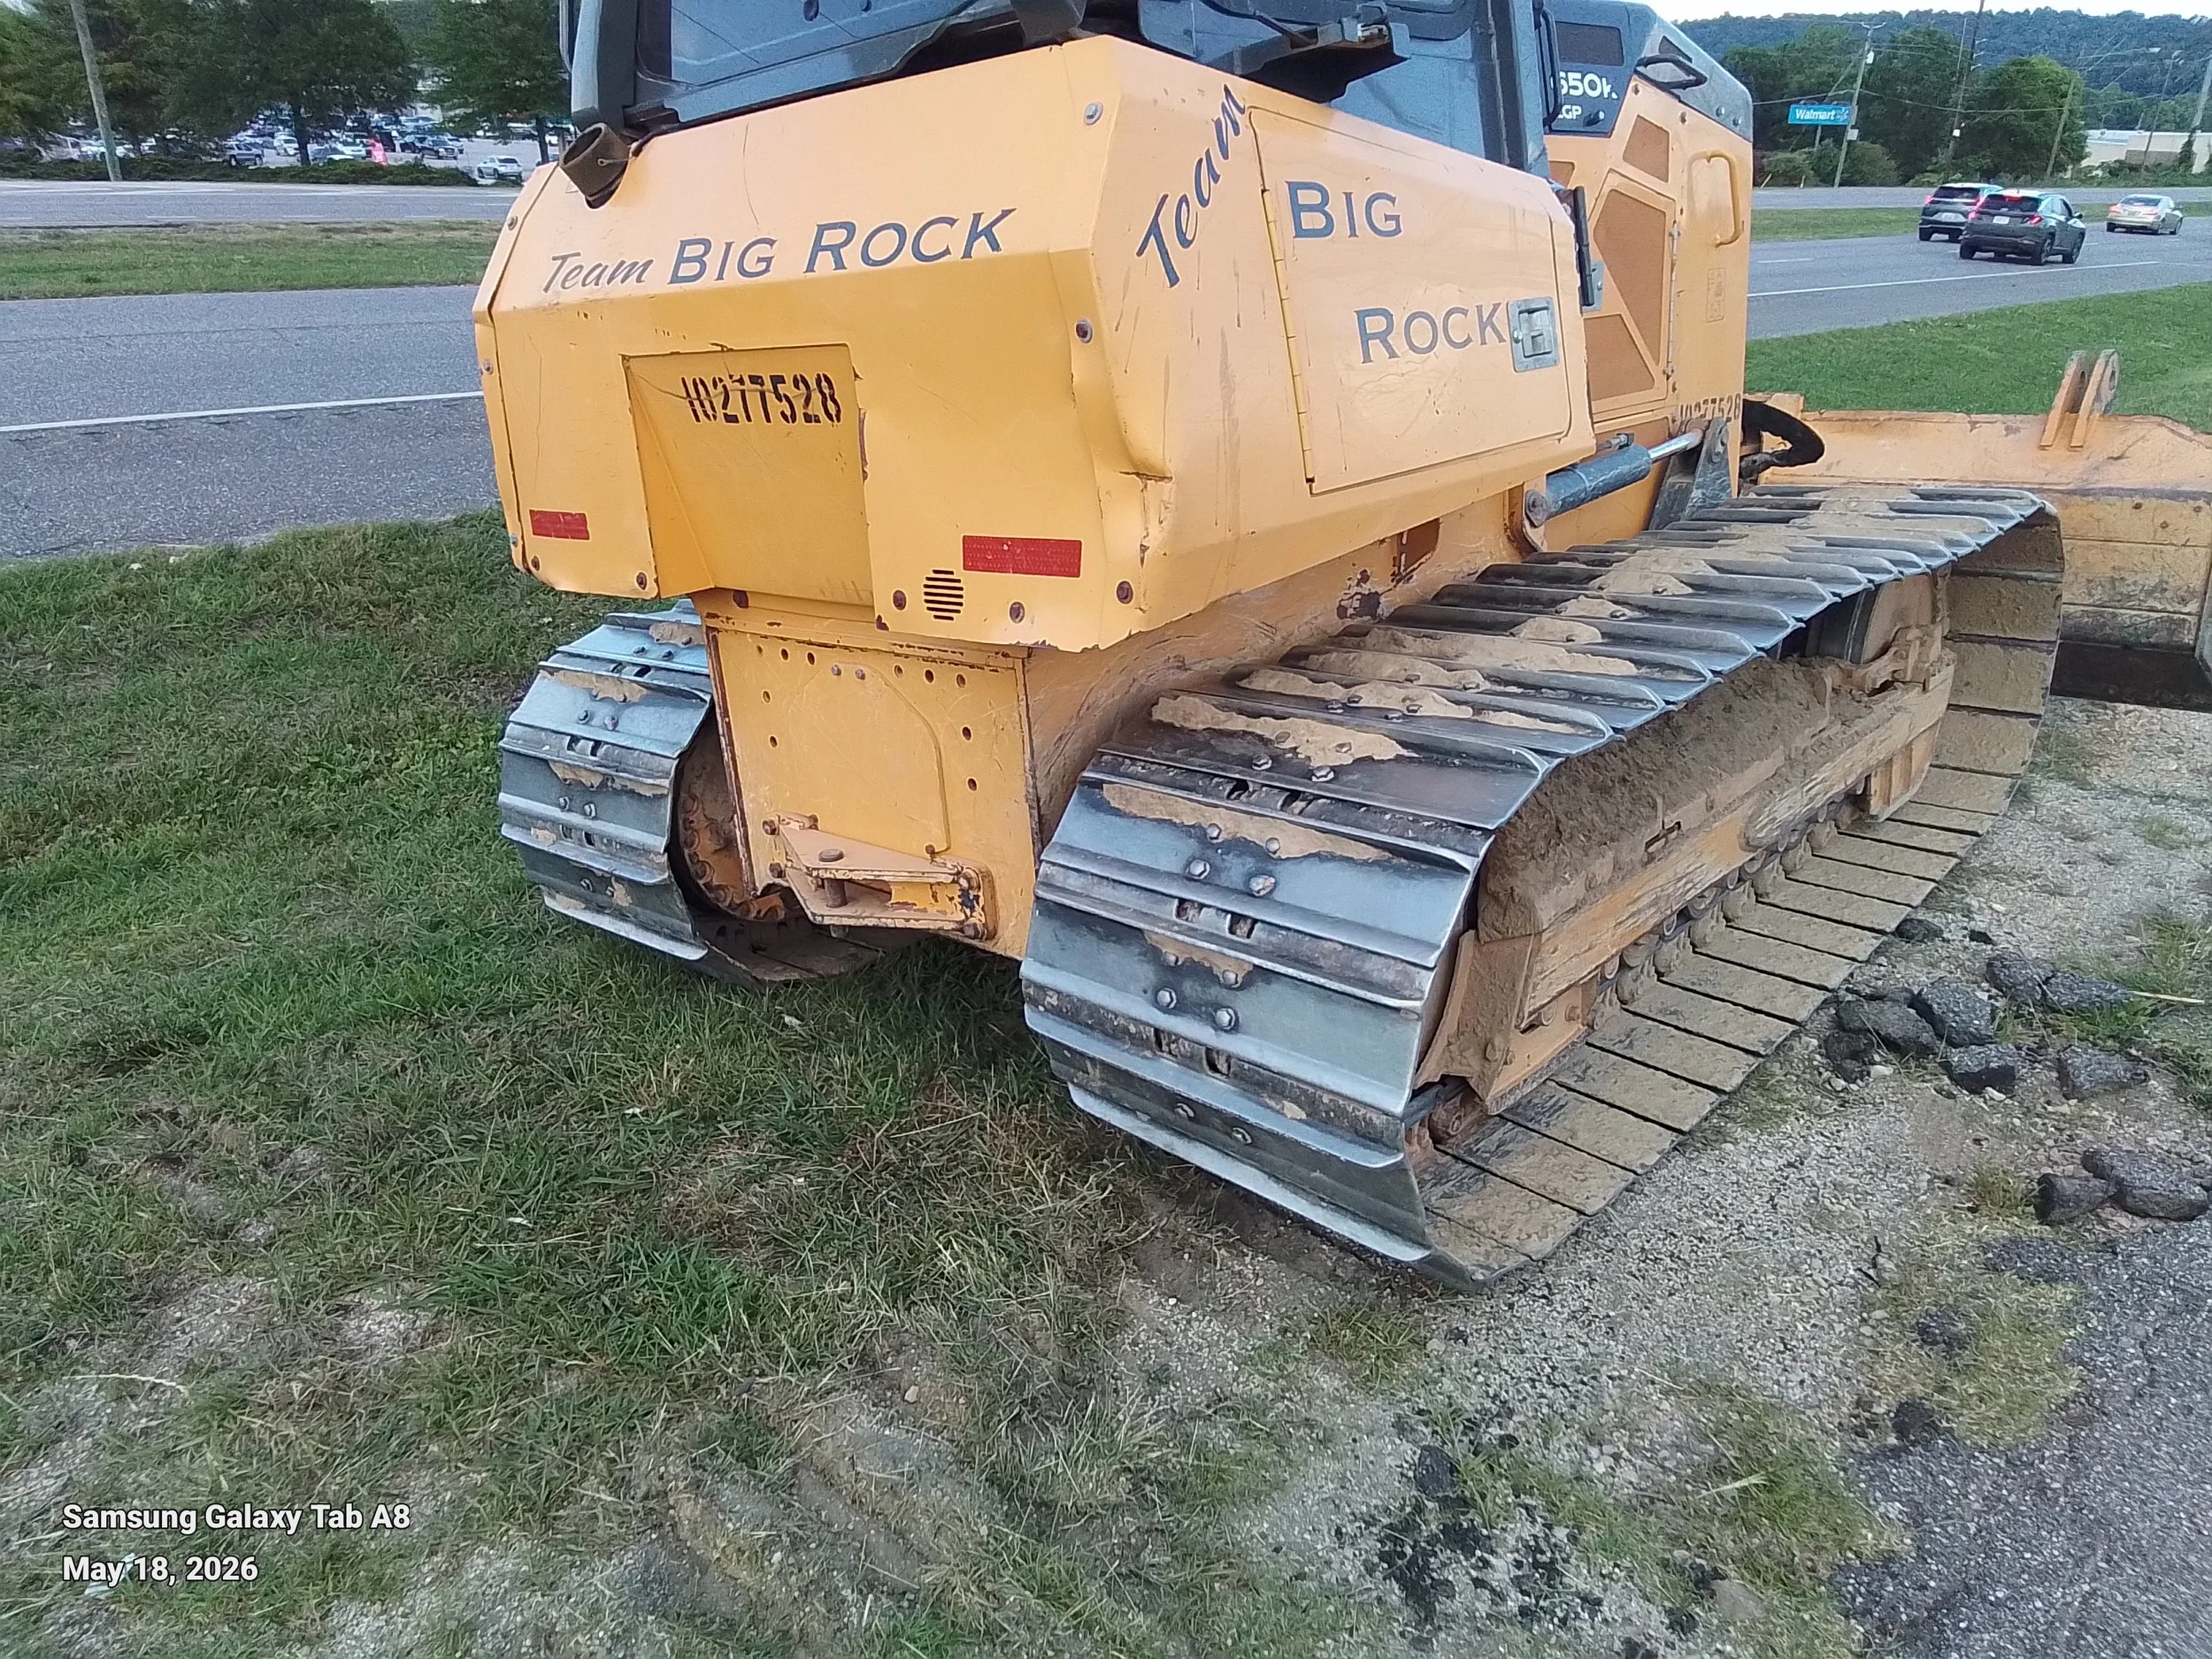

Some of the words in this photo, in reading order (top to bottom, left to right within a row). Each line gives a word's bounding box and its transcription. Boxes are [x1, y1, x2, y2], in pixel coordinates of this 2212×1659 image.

[1795, 108, 1836, 120] Walmart
[1136, 83, 1246, 289] Team
[1286, 180, 1403, 240] BIG
[542, 252, 654, 294] Team
[667, 237, 778, 285] BIG
[803, 208, 1017, 274] ROCK
[1354, 302, 1506, 365] ROCK
[680, 373, 841, 424] 10277528
